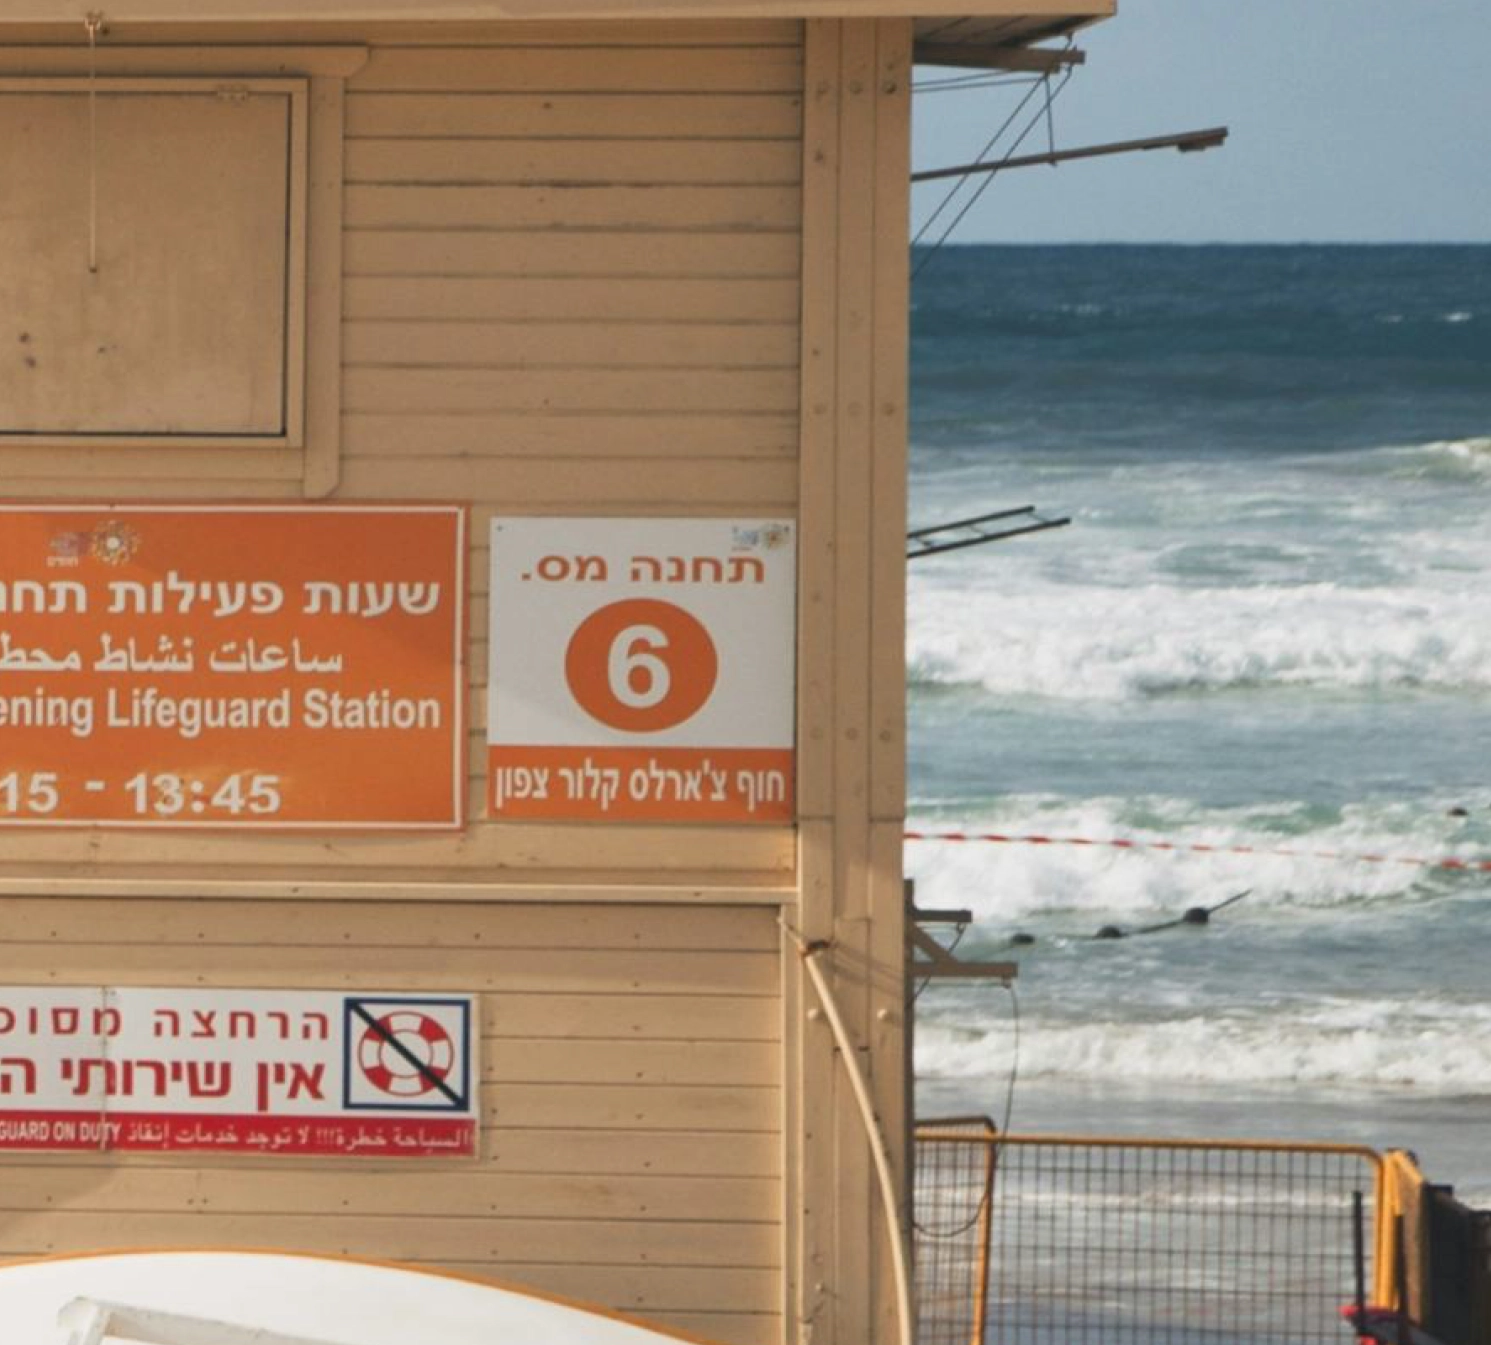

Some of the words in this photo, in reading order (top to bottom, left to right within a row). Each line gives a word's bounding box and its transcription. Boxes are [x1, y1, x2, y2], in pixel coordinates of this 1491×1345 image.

[521, 555, 608, 582] מס.
[630, 556, 765, 583] תחנה
[108, 570, 284, 617] פעילות
[303, 581, 439, 617] שעות
[93, 633, 194, 672] نشاط
[209, 637, 342, 672] ساعات
[608, 624, 671, 709] 6
[107, 688, 290, 738] Lifeguard
[303, 688, 440, 729] Station
[124, 772, 280, 814] 13:45
[496, 767, 549, 809] צפון
[559, 757, 620, 810] קלור
[737, 768, 785, 812] חוף
[154, 1009, 328, 1040] הרחצה
[61, 1058, 230, 1097] שירותי
[257, 1063, 325, 1112] אין
[53, 1121, 76, 1142] ON
[80, 1121, 121, 1143] DUTY
[175, 1123, 238, 1144] خدمات
[245, 1126, 292, 1149] توجد
[298, 1126, 310, 1144] لا
